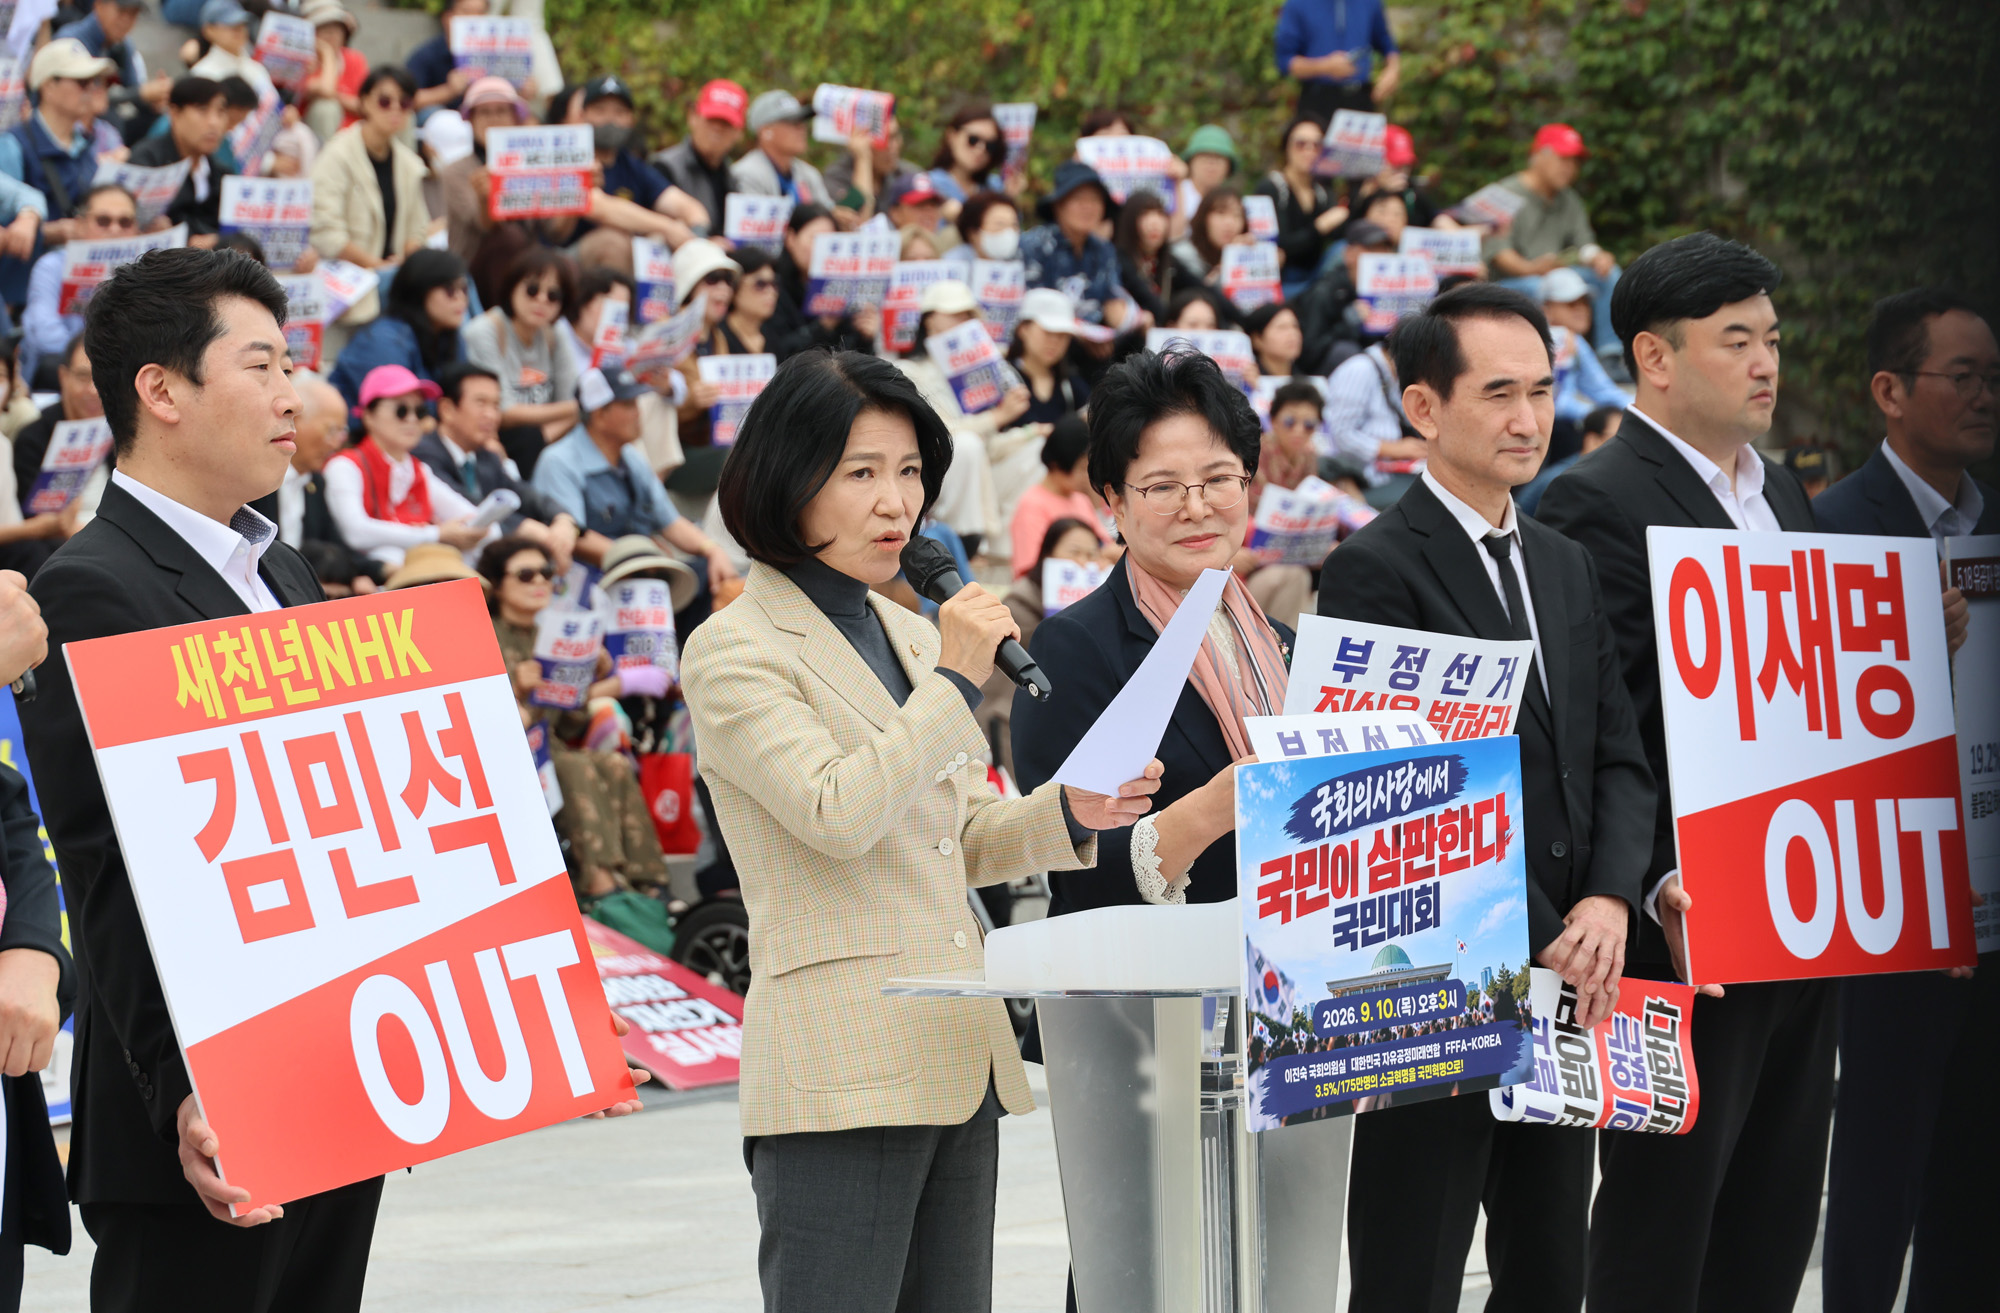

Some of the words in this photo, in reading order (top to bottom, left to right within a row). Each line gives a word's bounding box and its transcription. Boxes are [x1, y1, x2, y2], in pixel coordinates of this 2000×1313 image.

[171, 609, 432, 720] 새천년NHK
[1669, 545, 1915, 740] 이재명
[178, 691, 517, 944] 김민석
[1311, 760, 1449, 837] 국회의사당에서
[1257, 838, 1359, 925] 국민이
[1367, 792, 1512, 894] 심판한다
[1764, 798, 1958, 960] OUT
[1333, 881, 1440, 952] 국민대회
[350, 929, 595, 1145] OUT
[1285, 1065, 1308, 1084] 이진숙
[1309, 1058, 1346, 1079] 국회의원실
[1351, 1053, 1381, 1071] 대한민국
[1382, 1043, 1441, 1067] 자유공정미래연합
[1445, 1033, 1502, 1055] FFFA-KOREA
[1322, 1010, 1359, 1029] 2026.
[1361, 1002, 1374, 1022] 9.
[1418, 989, 1458, 1014] 오후3시
[1315, 1074, 1378, 1098] 3.5%/175만명의
[1380, 1066, 1416, 1087] 소금혁명을
[1417, 1059, 1464, 1080] 국민혁명으로!
